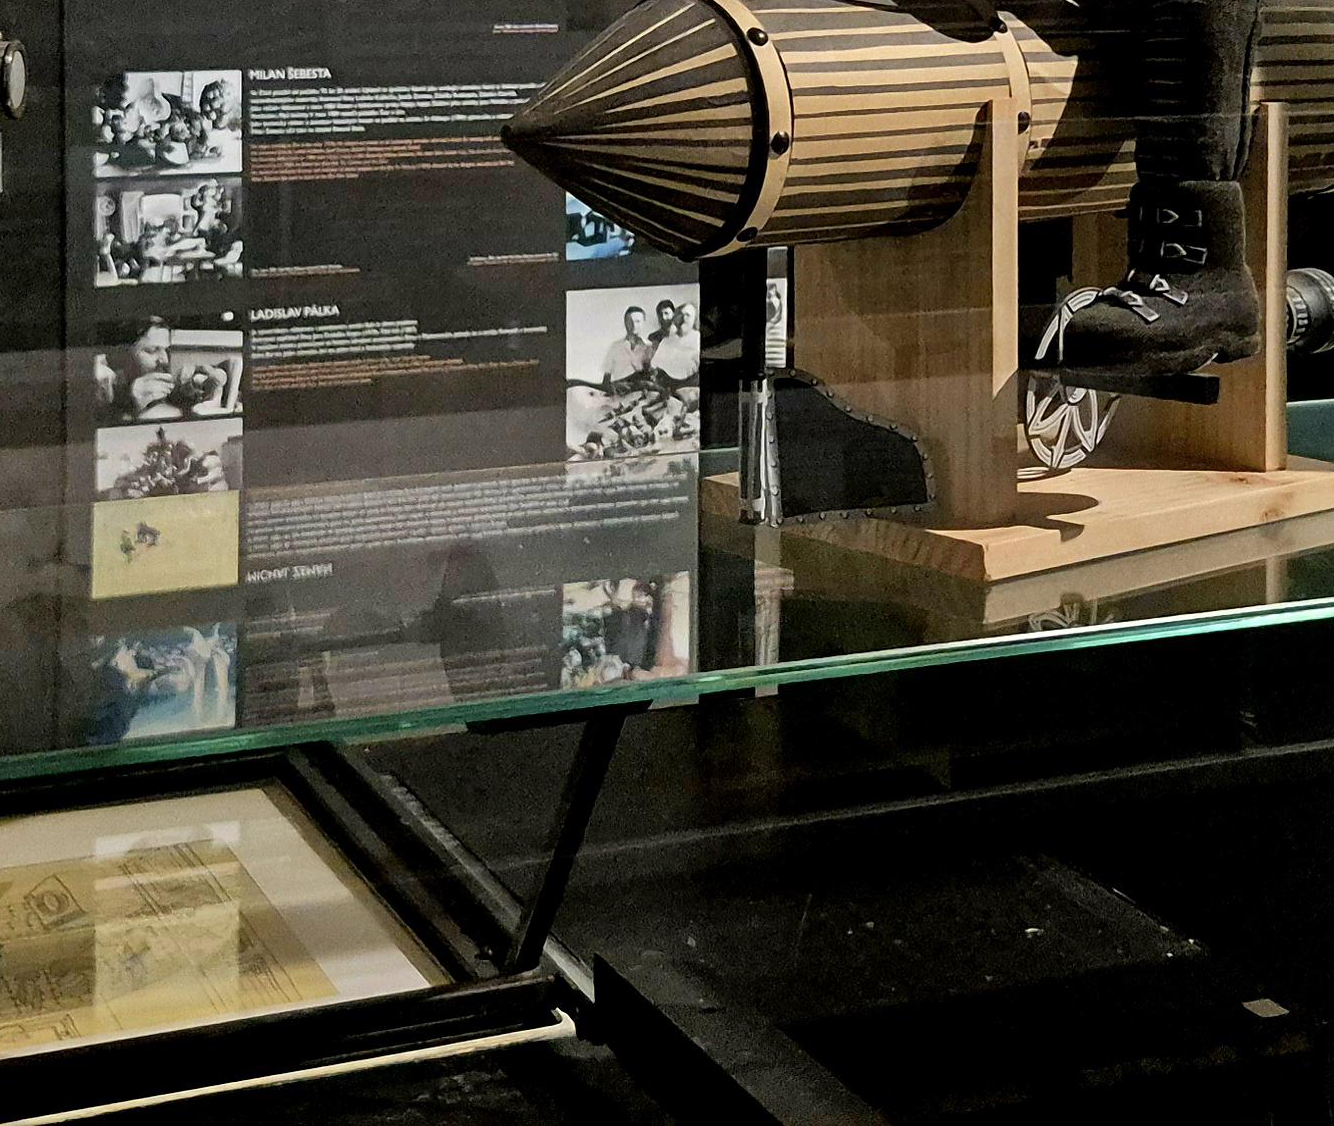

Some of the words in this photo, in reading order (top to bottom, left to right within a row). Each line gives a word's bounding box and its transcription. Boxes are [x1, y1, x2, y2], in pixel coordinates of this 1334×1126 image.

[249, 68, 286, 80] MILAN
[287, 66, 332, 80] ŠEBESTA
[251, 307, 302, 322] LADISLAV
[303, 304, 340, 318] PÁLKA
